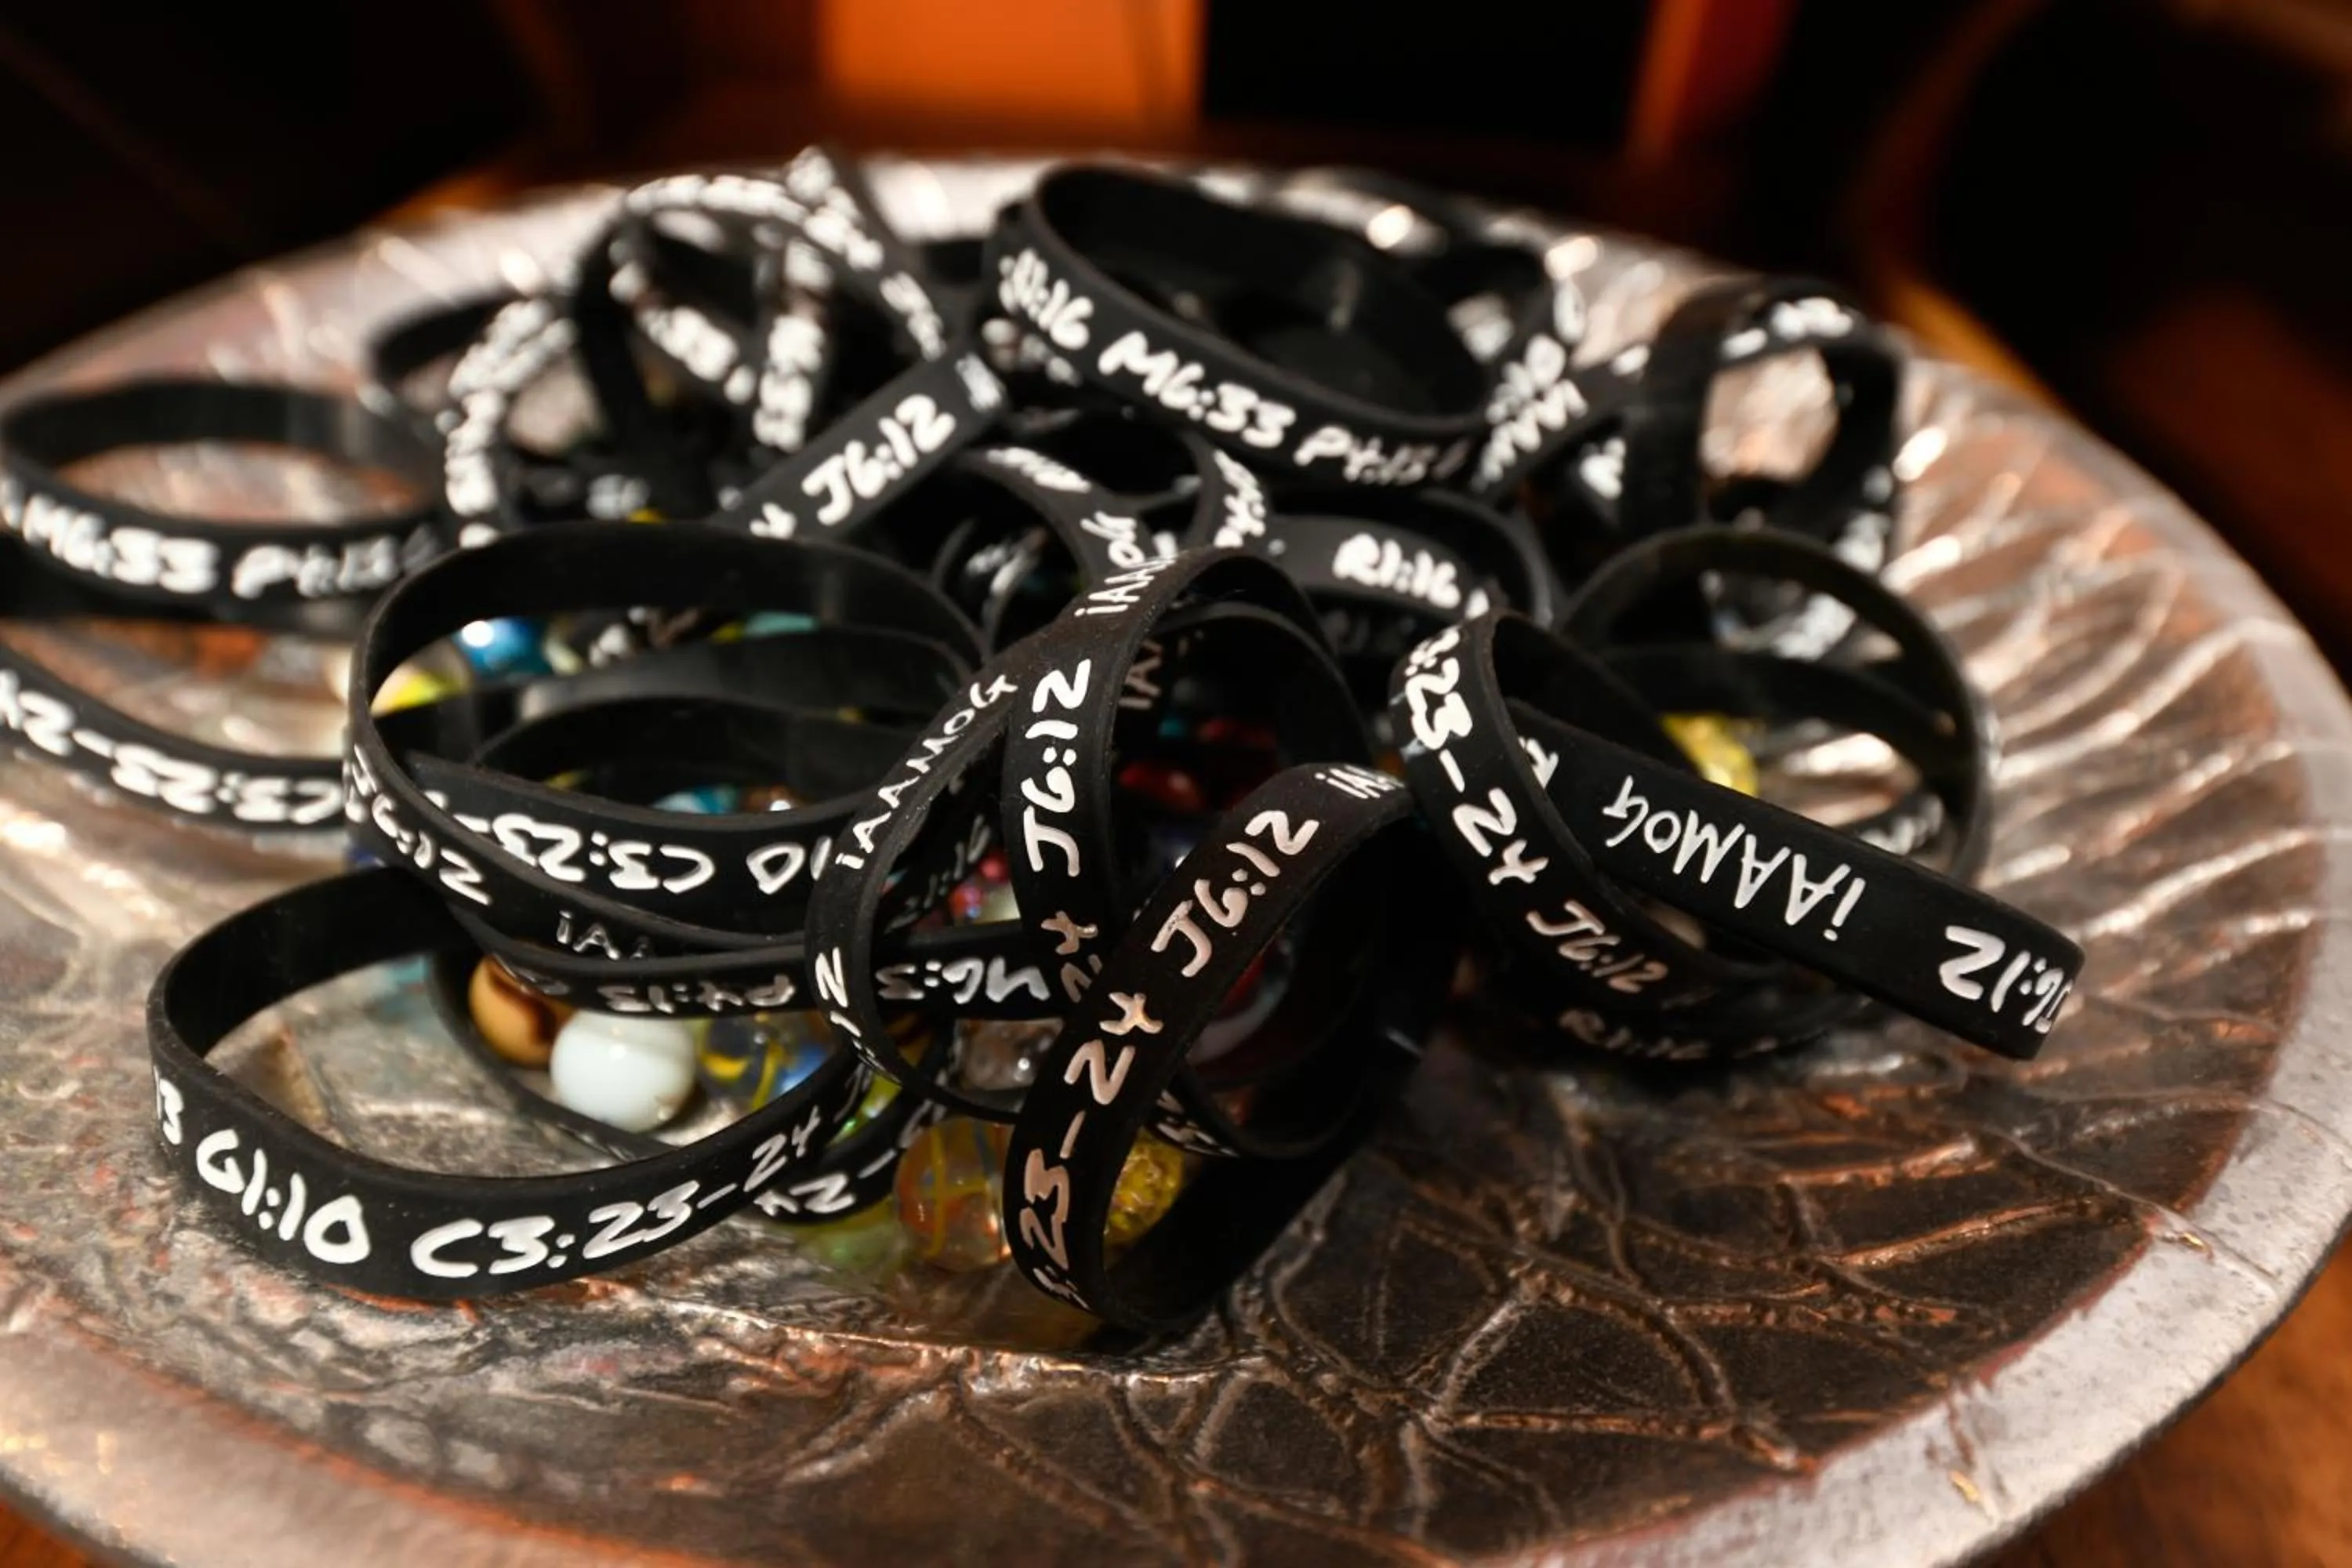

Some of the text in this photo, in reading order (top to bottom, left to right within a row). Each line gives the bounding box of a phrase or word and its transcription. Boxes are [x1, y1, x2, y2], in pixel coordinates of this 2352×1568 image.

[1098, 332, 1295, 448] M6:33
[801, 394, 956, 525] J6:12
[1333, 533, 1460, 609] R1:16
[1021, 659, 1091, 877] J6:12
[1151, 810, 1320, 977] J6:12
[1526, 899, 1668, 993] J6:12
[197, 1129, 370, 1264] G1:10
[410, 1105, 819, 1279] C3:23-24
